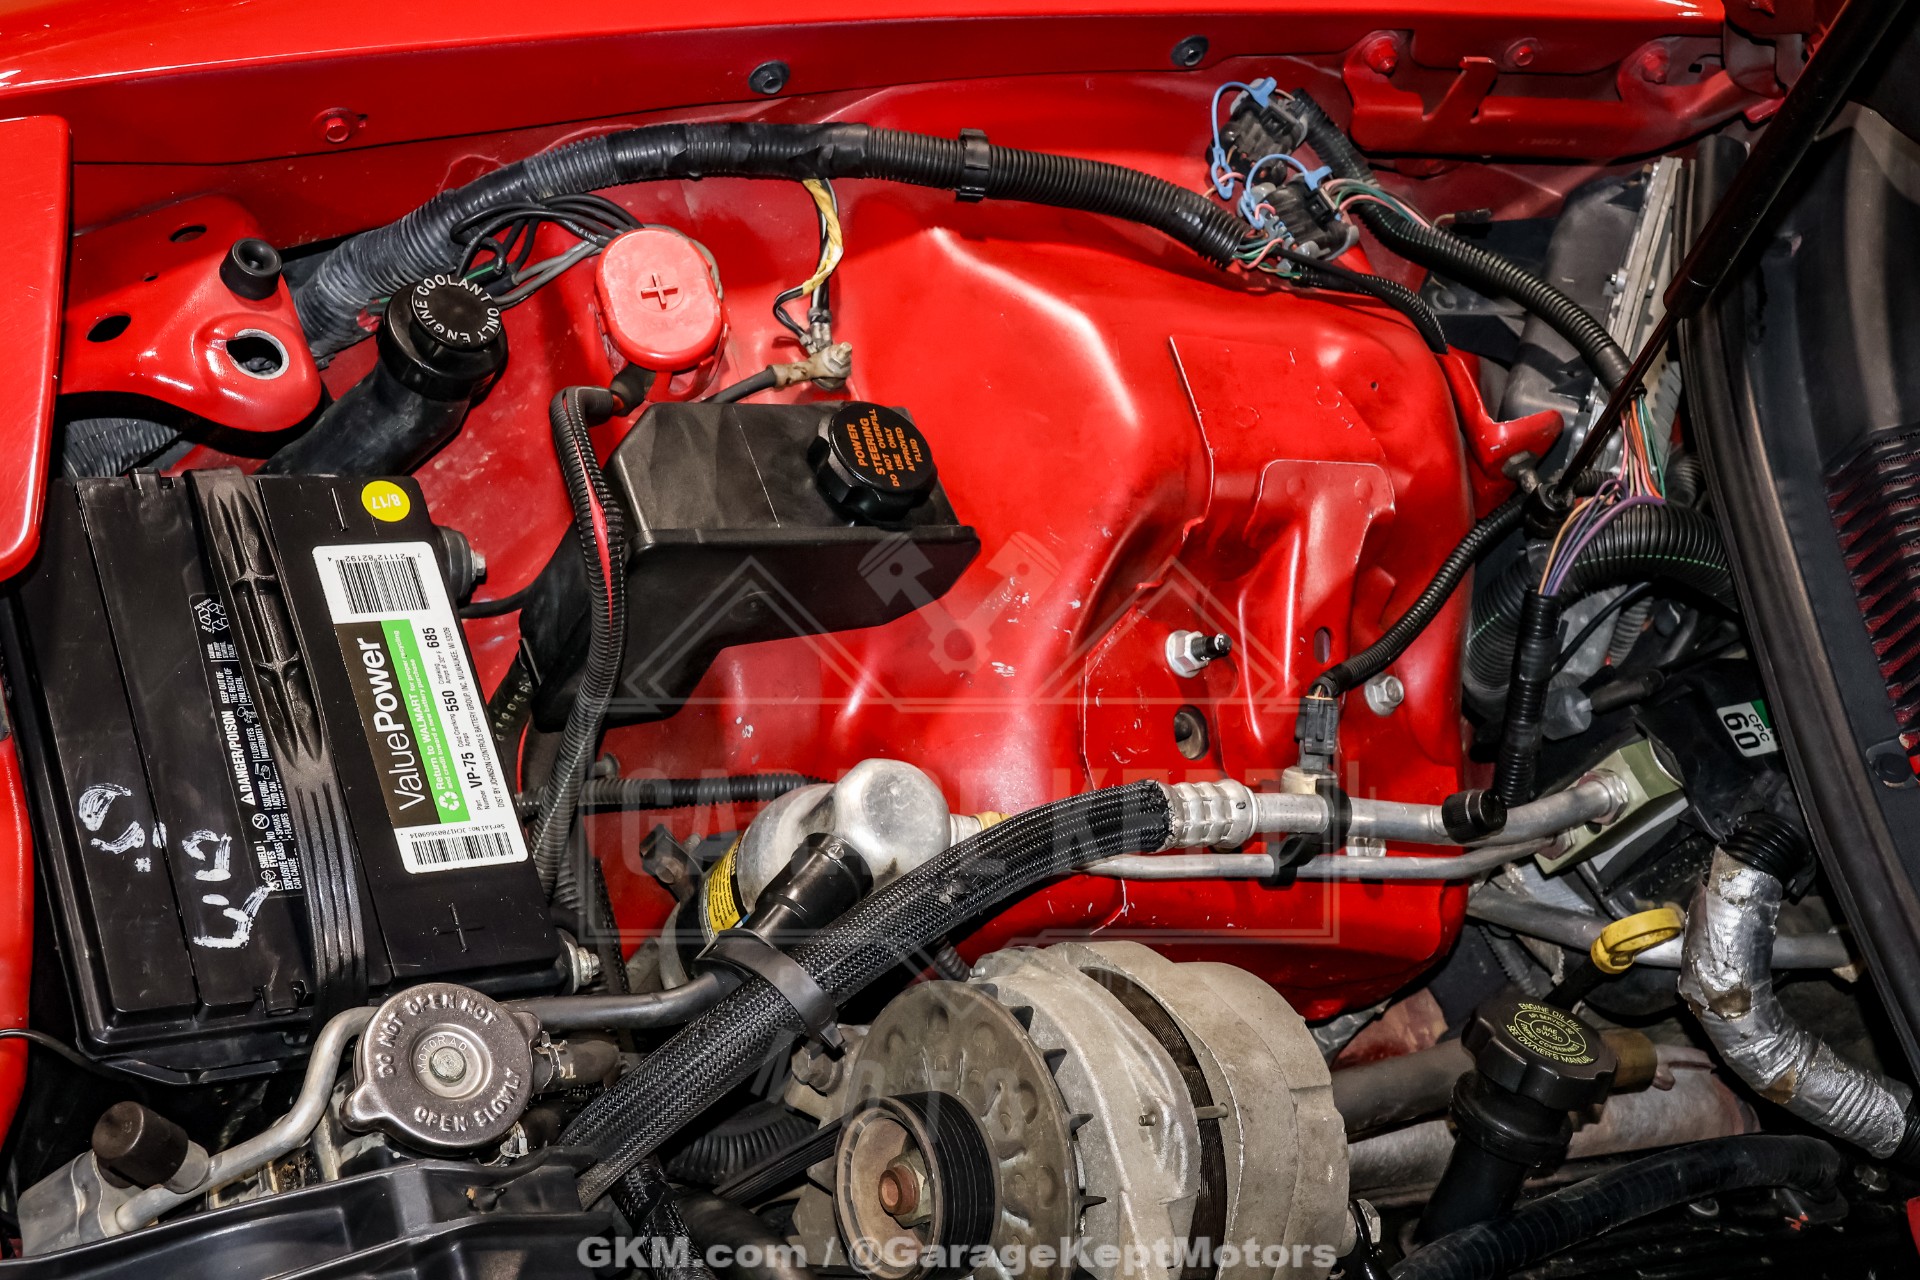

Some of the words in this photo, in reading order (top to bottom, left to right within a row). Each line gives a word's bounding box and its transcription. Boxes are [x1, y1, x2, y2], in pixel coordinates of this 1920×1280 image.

[417, 274, 492, 302] COOLANT
[415, 300, 471, 343] ENGINE
[477, 308, 499, 342] ONLY
[869, 409, 886, 448] OVERFILL
[884, 427, 897, 448] ONLY
[847, 424, 868, 467] POWER
[860, 418, 886, 475] STEERING
[895, 427, 915, 472] APPROVED
[910, 438, 923, 462] FLUID
[882, 453, 894, 470] NOT
[893, 453, 904, 470] USE
[890, 474, 900, 487] DO
[371, 494, 402, 510] 8/17
[394, 631, 406, 658] recycling
[422, 628, 439, 648] 685
[216, 671, 224, 679] OF
[224, 667, 232, 675] OF
[403, 660, 415, 681] proper
[410, 659, 424, 688] purchase
[218, 679, 226, 690] OUT
[226, 676, 236, 693] REACH
[220, 691, 230, 703] KEEP
[230, 693, 238, 703] THE
[420, 689, 430, 712] battery
[442, 690, 459, 712] 550
[357, 637, 426, 810] ValuePower
[409, 694, 431, 743] WALMART
[450, 714, 460, 735] Cranking
[469, 712, 482, 732] BATTERY
[1749, 714, 1770, 742] CPC
[246, 727, 256, 741] EYES
[463, 733, 471, 746] Amps
[1723, 712, 1760, 750] 60
[221, 711, 254, 793] DANGER/POISON
[249, 740, 260, 759] FLUSH
[427, 746, 435, 755] to
[431, 733, 443, 755] toward
[476, 734, 491, 760] CONTROLS
[431, 758, 446, 789] Return
[439, 756, 449, 775] credit
[461, 752, 482, 788] VP-75
[485, 761, 498, 786] JOHNSON
[268, 781, 277, 792] CAN
[445, 776, 454, 788] and
[258, 781, 272, 807] SULFURIC
[270, 793, 281, 806] ACID
[480, 790, 490, 809] Number
[495, 795, 505, 808] DIST.
[272, 814, 283, 835] SPARKS
[281, 813, 292, 834] FLAMES
[482, 824, 505, 832] Serial
[266, 831, 276, 840] NO
[256, 846, 269, 869] SHIELD
[267, 851, 278, 868] EYES
[274, 842, 286, 860] GASES
[279, 861, 294, 890] EXPLOSIVE
[287, 858, 299, 877] CAUSE
[293, 877, 302, 890] CAN
[405, 993, 458, 1016] OPEN
[461, 998, 499, 1025] HOT
[1518, 1003, 1549, 1013] ENGINE
[1552, 1010, 1565, 1020] OIL
[1567, 1020, 1582, 1032] FILL
[378, 1012, 405, 1048] NOT
[1536, 1028, 1563, 1042] 5W-30
[1543, 1025, 1558, 1034] SAE
[417, 1035, 467, 1074] MOTORAD
[1506, 1024, 1521, 1036] SEE
[1518, 1036, 1559, 1060] OWNER'S
[1560, 1056, 1594, 1064] MANUAL
[376, 1052, 396, 1078] DO
[414, 1105, 468, 1132] OPEN
[473, 1067, 522, 1127] SLOWLY
